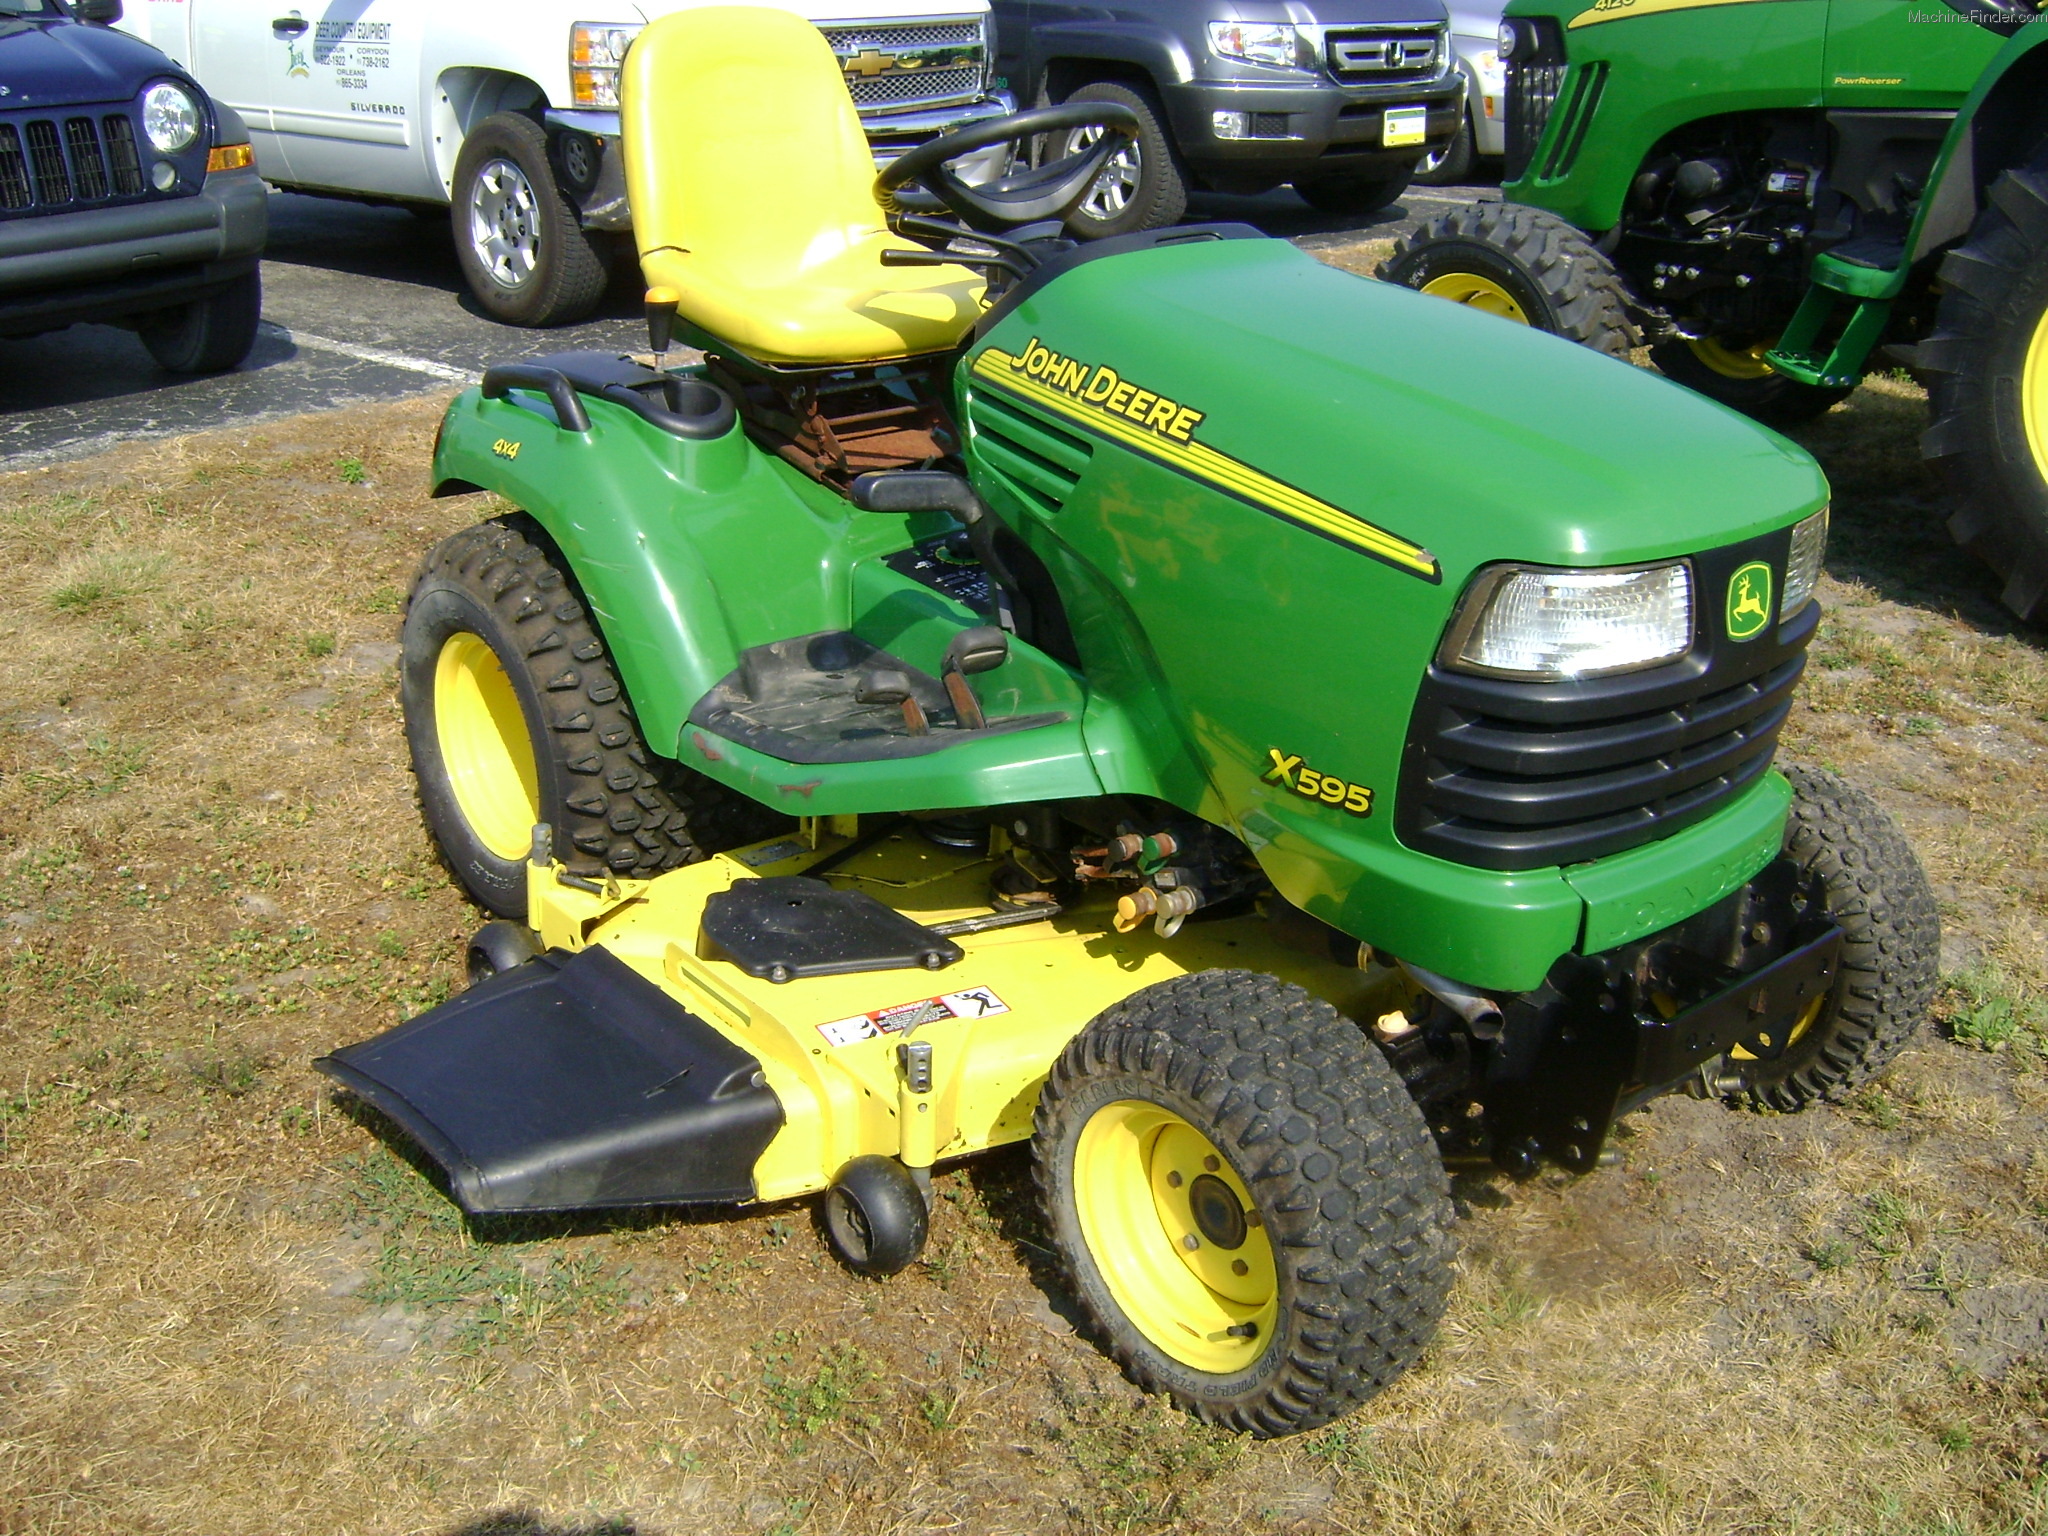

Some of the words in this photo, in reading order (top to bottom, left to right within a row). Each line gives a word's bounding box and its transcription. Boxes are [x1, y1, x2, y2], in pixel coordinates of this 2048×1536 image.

[315, 21, 330, 38] DEER
[331, 21, 356, 39] COUNTRY
[358, 22, 392, 41] EQUIPMENT
[315, 46, 345, 55] SEYMOUR
[356, 47, 390, 56] CORYDON
[336, 68, 366, 77] ORLEANS
[1834, 76, 1903, 86] PowrReverser
[350, 102, 405, 116] SILVERADO
[1010, 337, 1091, 396] JOHN
[1083, 365, 1205, 444] DEERE
[1261, 748, 1375, 818] X595
